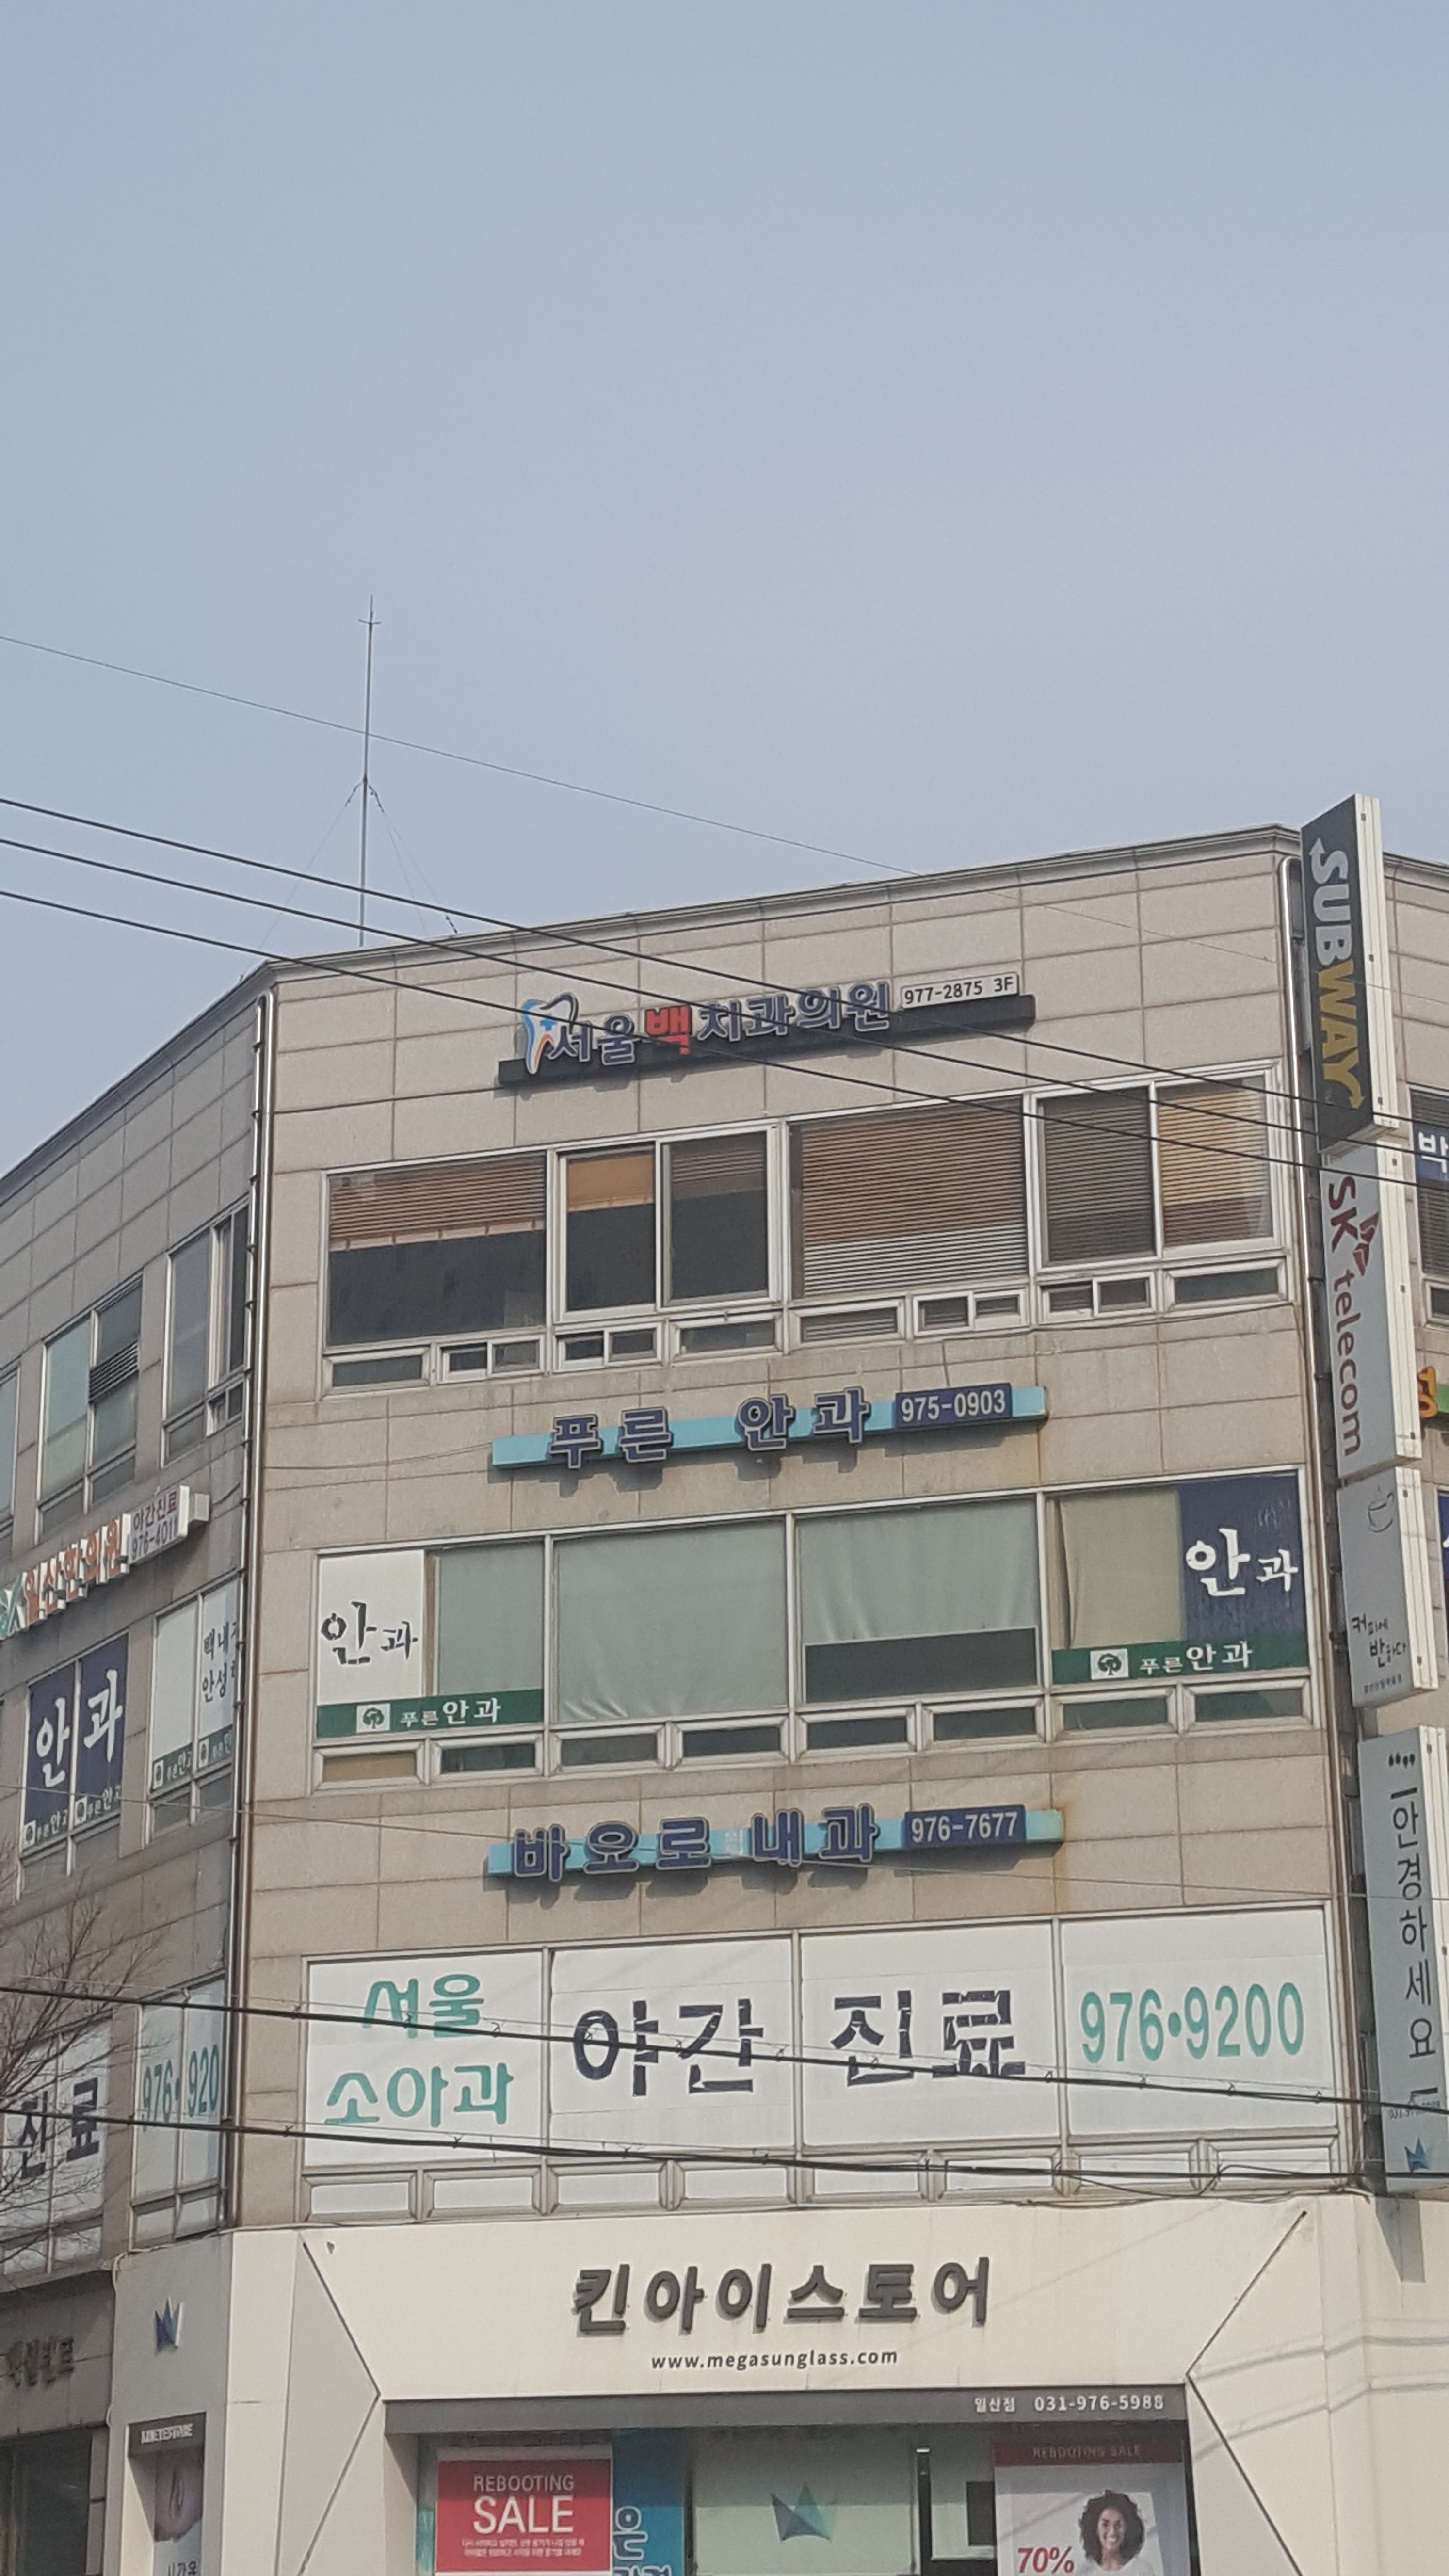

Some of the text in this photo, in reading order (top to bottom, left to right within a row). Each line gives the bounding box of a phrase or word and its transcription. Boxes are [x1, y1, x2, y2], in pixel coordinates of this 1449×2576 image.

[1309, 838, 1365, 1109] SUBWAY
[547, 975, 1014, 1066] 서울백치과의원 977-2875 3F
[1328, 1175, 1362, 1456] SK telecom
[549, 1385, 1006, 1469] 푸른 안과 975-0903
[1186, 1527, 1299, 1596] 안과
[321, 1601, 419, 1665] 안과
[36, 1668, 123, 1788] 안과
[513, 1817, 712, 1882] 바오로
[751, 1803, 881, 1867] 내과
[912, 1810, 1018, 1844] 976-7677
[362, 1973, 484, 2038] 서울
[324, 2062, 514, 2127] 소아과
[574, 2257, 990, 2334] 킨아이스토어
[651, 2350, 898, 2371] www.megasunglass.com
[1034, 2394, 1164, 2412] 031-976-5988
[473, 2474, 574, 2492] REBOOTING
[473, 2495, 574, 2534] SALE
[1018, 2546, 1074, 2574] 70%
